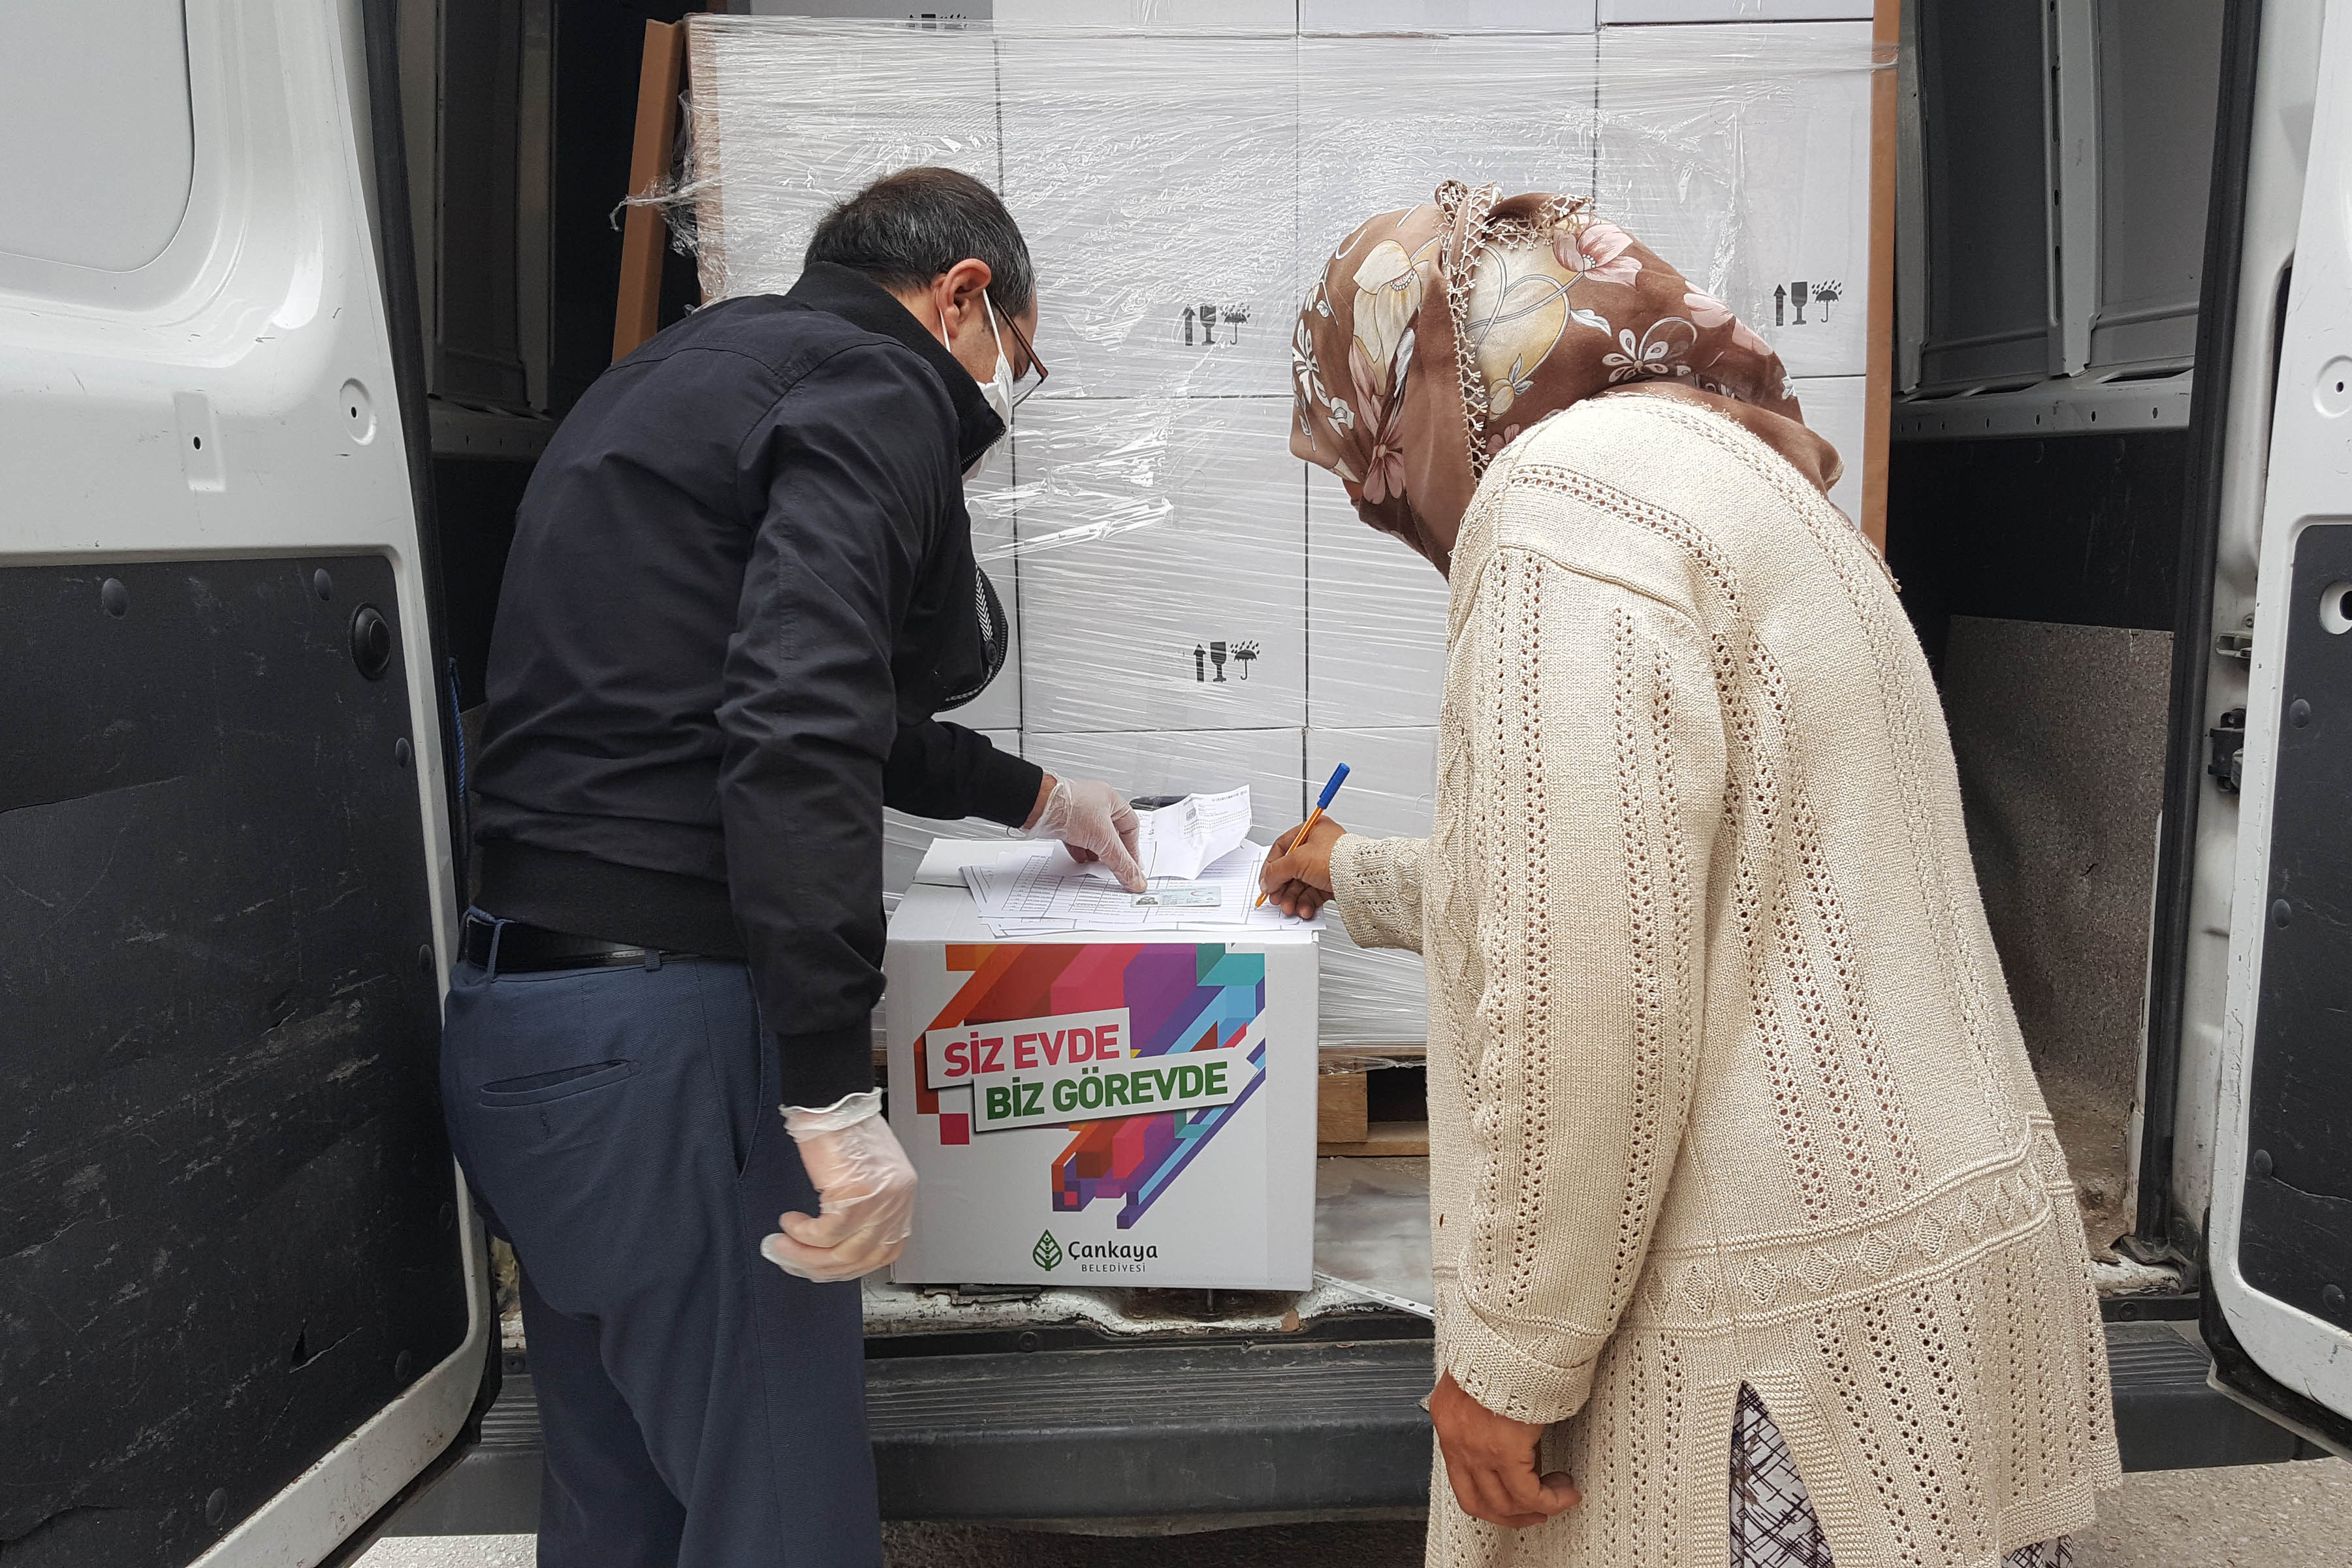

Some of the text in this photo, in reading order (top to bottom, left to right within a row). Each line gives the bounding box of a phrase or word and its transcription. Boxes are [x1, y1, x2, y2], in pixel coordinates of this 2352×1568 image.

[944, 1024, 1120, 1077] SİZ EVDE
[987, 1061, 1228, 1120] BİZ GÖREVDE
[1068, 1240, 1158, 1262] Çankaya
[1081, 1262, 1145, 1272] BELEDİYESİ
